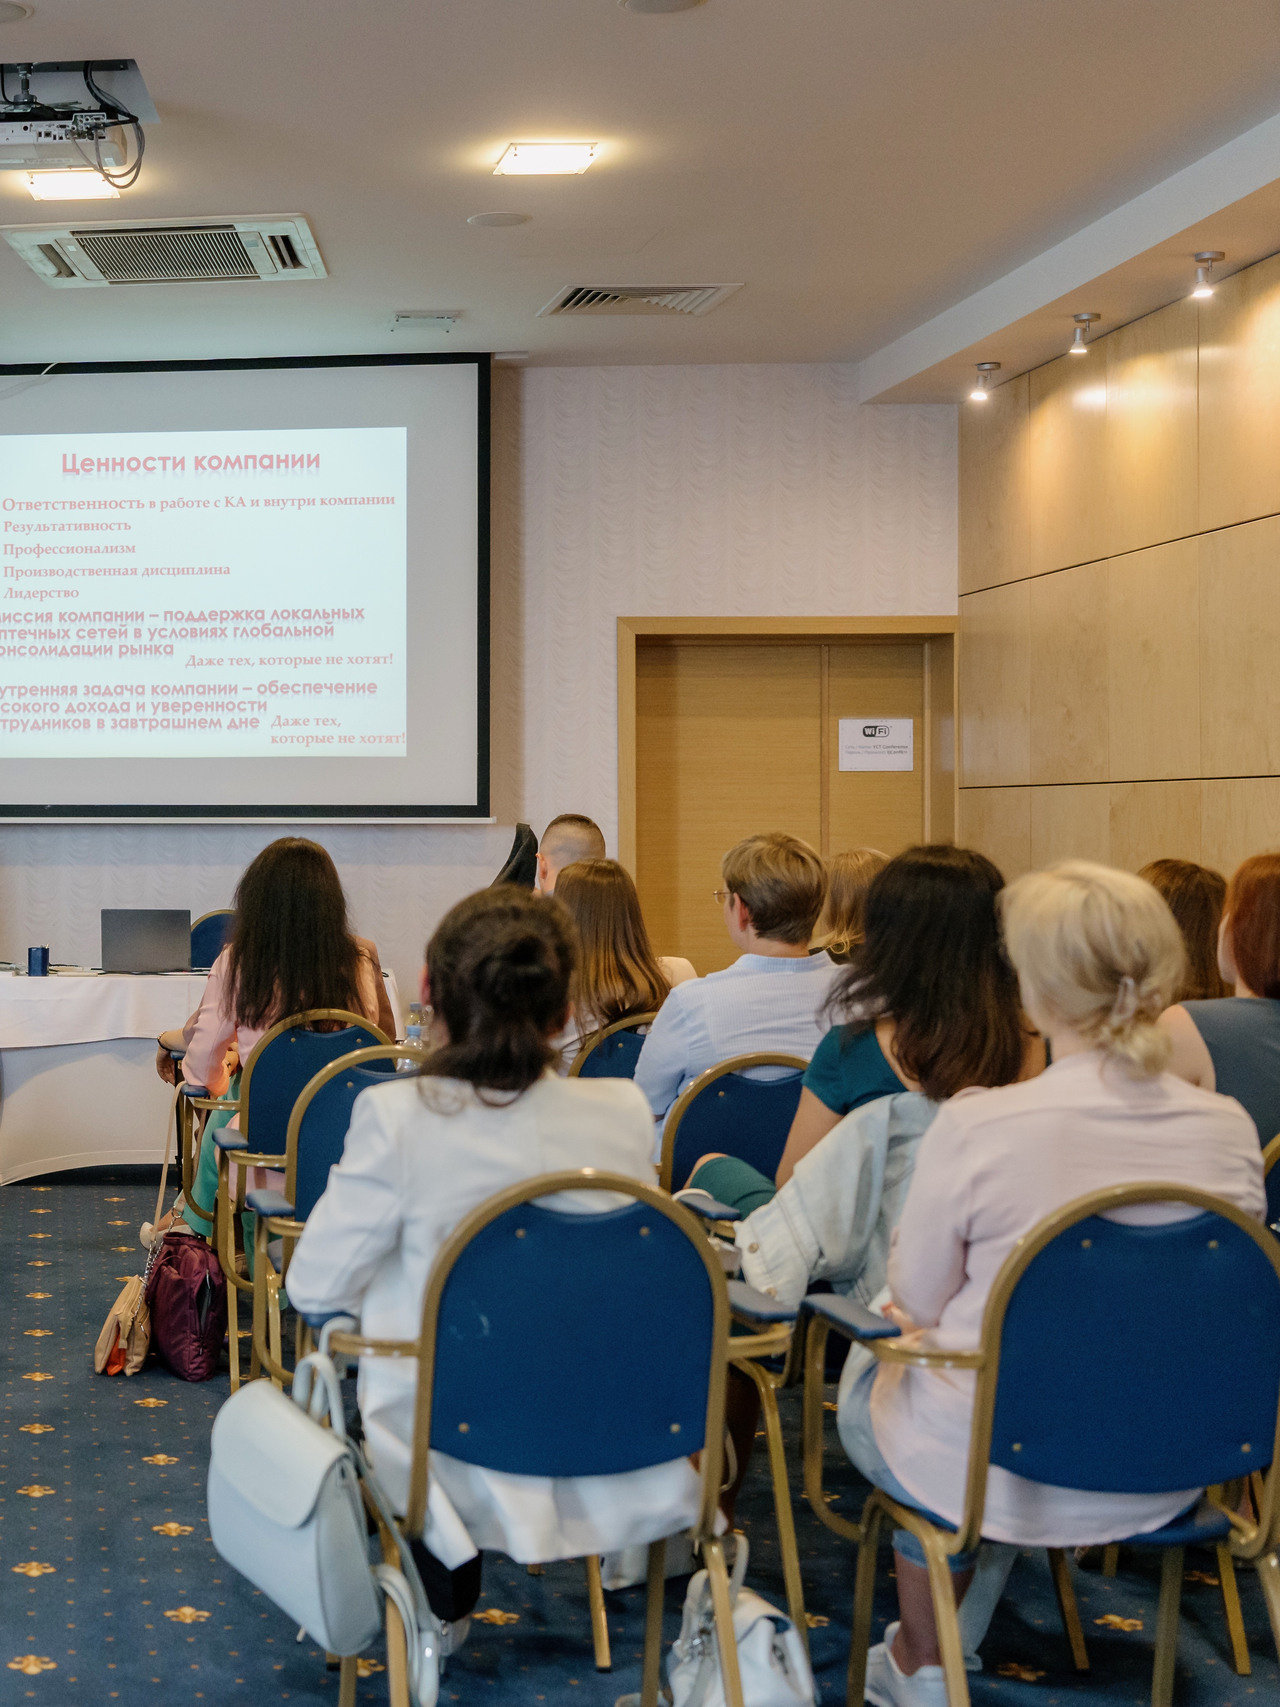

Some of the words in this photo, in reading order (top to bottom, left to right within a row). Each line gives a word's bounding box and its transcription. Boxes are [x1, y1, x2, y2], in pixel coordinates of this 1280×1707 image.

[62, 453, 185, 475] Ценности
[194, 453, 320, 470] компании
[2, 498, 145, 511] Ответственность
[149, 500, 156, 508] в
[160, 497, 210, 512] работе
[214, 499, 220, 508] с
[224, 496, 246, 508] КА
[251, 499, 259, 507] и
[264, 497, 315, 510] внутри
[320, 496, 395, 506] компании
[3, 521, 131, 535] Результативность
[3, 543, 136, 558] Профессионализм
[3, 566, 137, 580] Производственная
[141, 566, 230, 578] дисциплина
[3, 587, 79, 602] Лидерство
[58, 610, 144, 623] компании
[164, 609, 265, 623] поддержка
[270, 608, 365, 620] локальных
[76, 624, 128, 639] сетей
[134, 628, 142, 638] в
[148, 626, 228, 641] условиях
[234, 622, 334, 638] глобальной
[119, 644, 174, 658] рынка
[185, 655, 224, 668] Даже
[228, 656, 255, 667] тех,
[259, 655, 322, 668] которые
[326, 655, 343, 665] не
[347, 653, 393, 664] хотят!
[83, 684, 145, 697] задача
[151, 684, 238, 696] компании
[257, 680, 378, 695] обеспечение
[65, 701, 130, 714] дохода
[136, 702, 145, 712] и
[151, 700, 267, 715] уверенности
[97, 719, 105, 729] в
[111, 717, 222, 732] завтрашнем
[227, 718, 259, 729] дне
[271, 715, 310, 728] Даже
[314, 717, 341, 727] тех,
[271, 734, 334, 747] которые
[338, 734, 355, 743] не
[360, 732, 405, 743] хотят!
